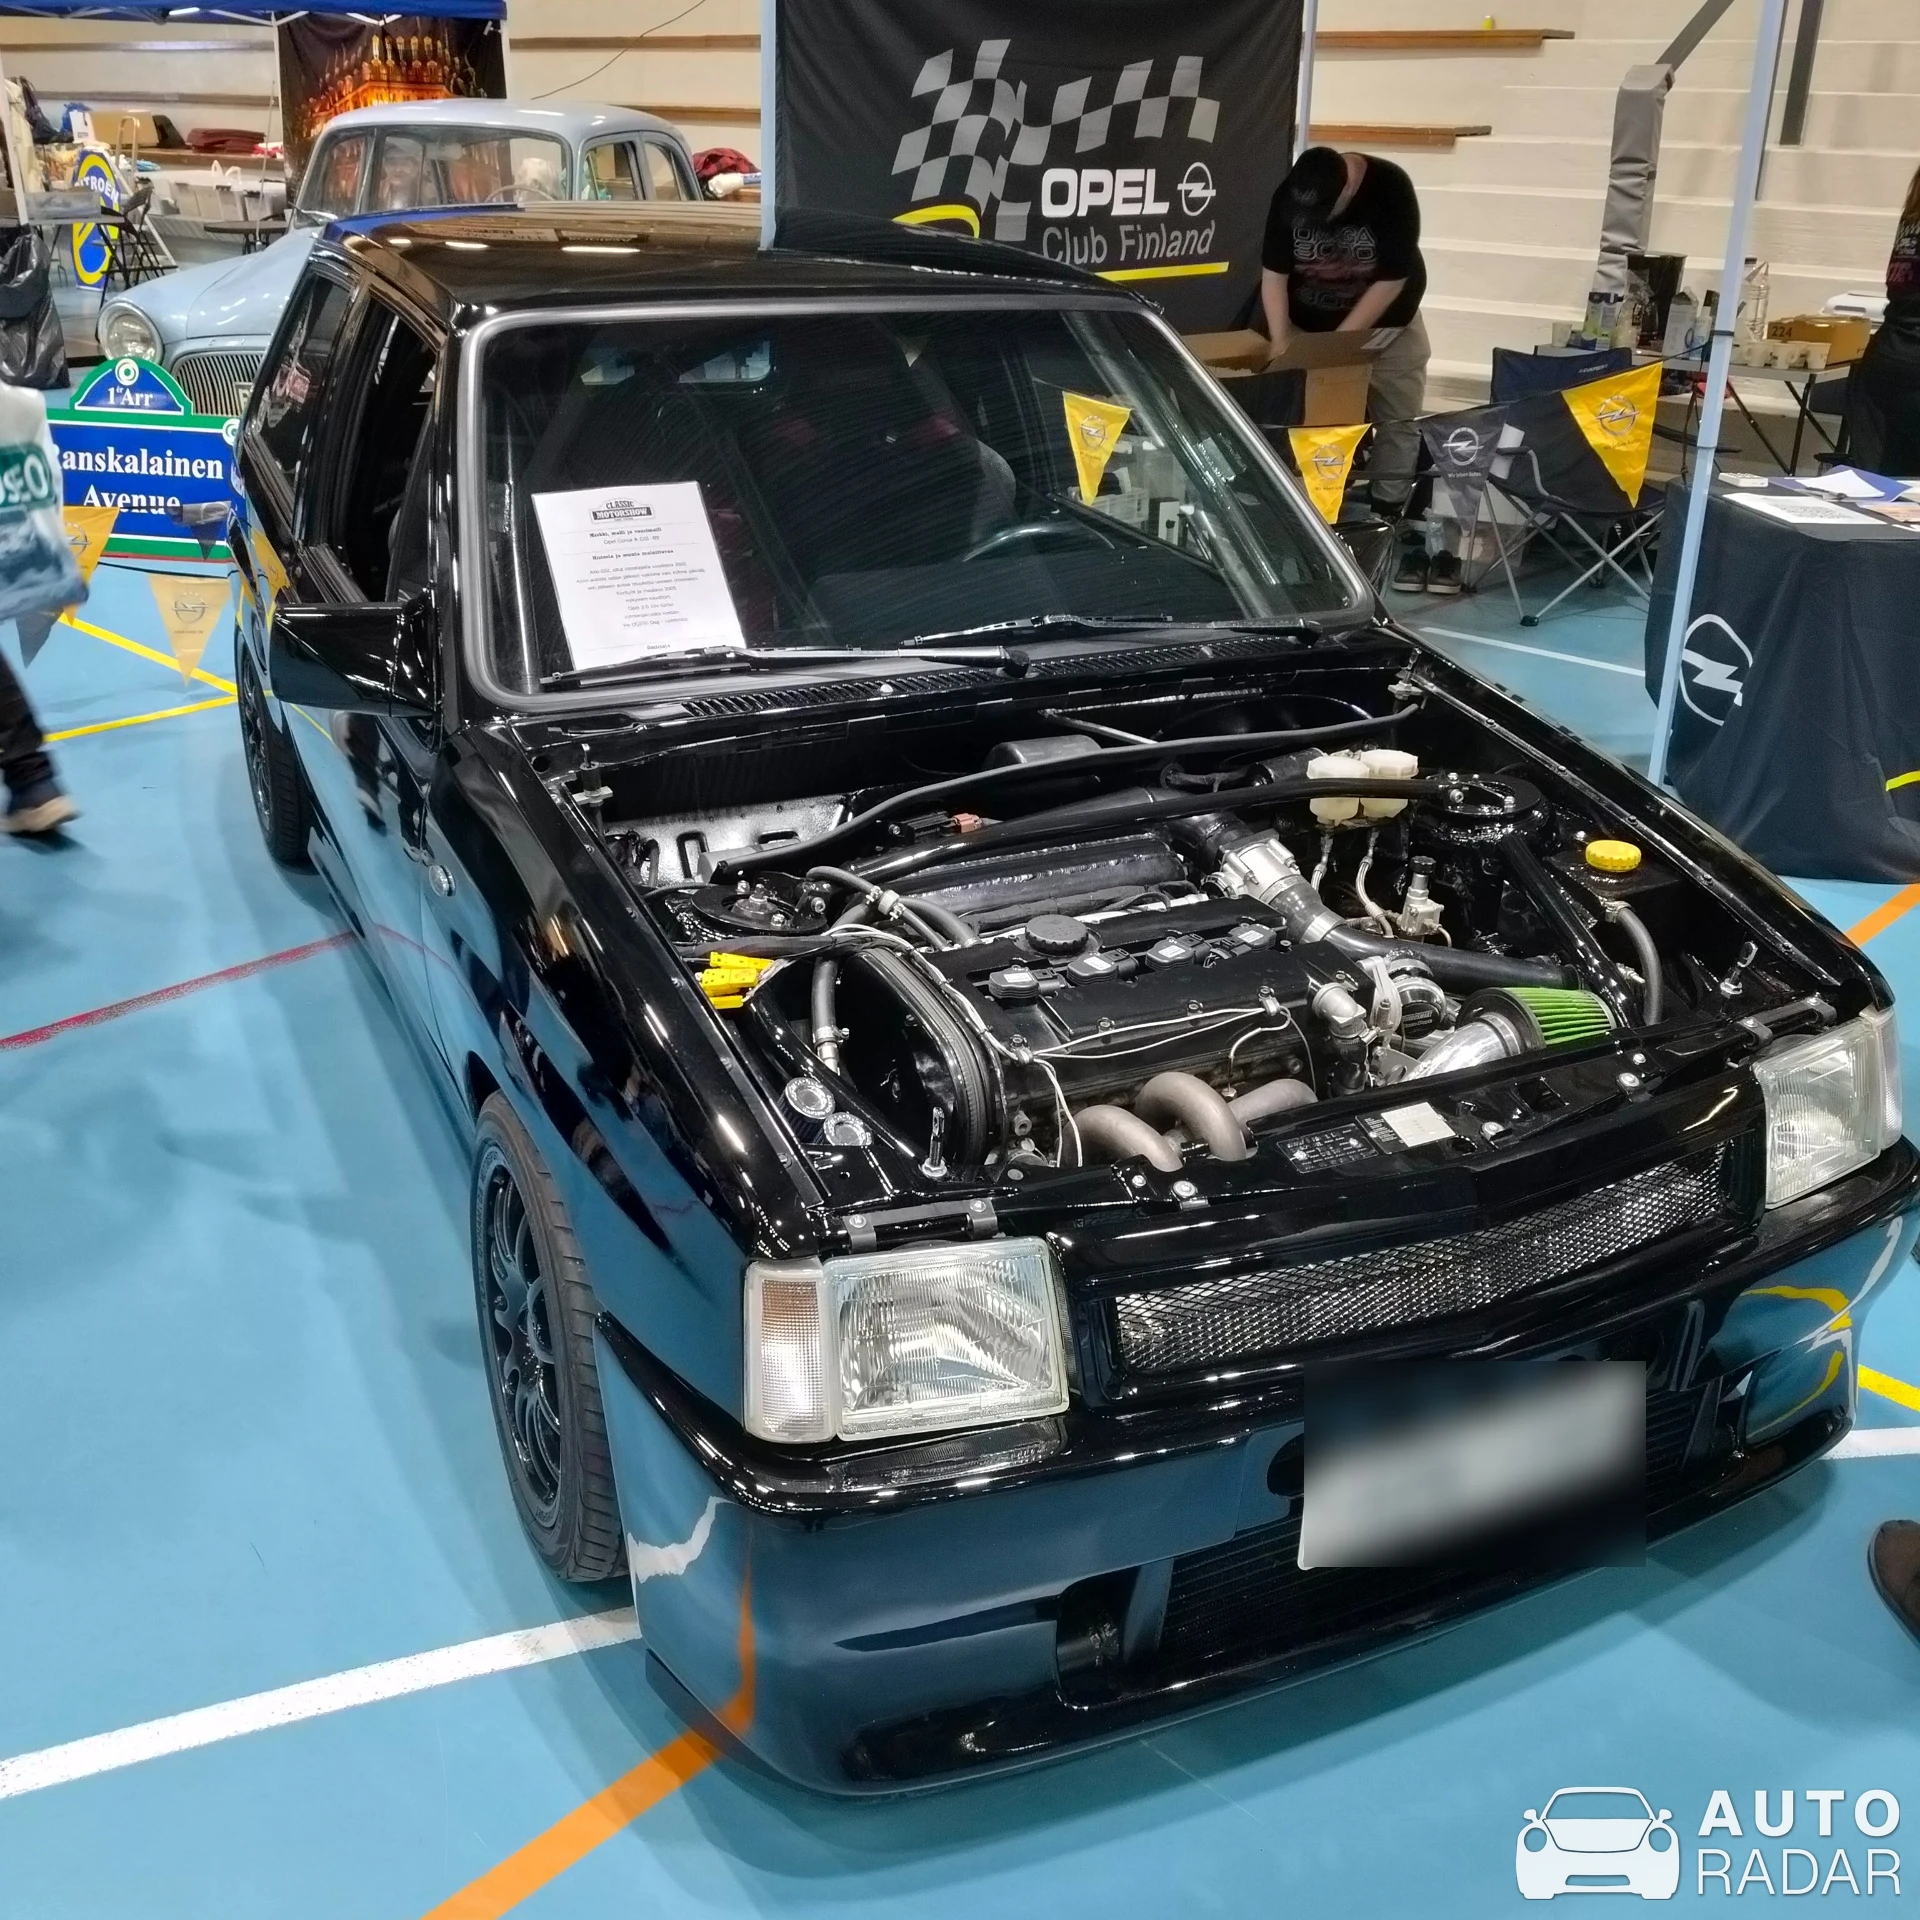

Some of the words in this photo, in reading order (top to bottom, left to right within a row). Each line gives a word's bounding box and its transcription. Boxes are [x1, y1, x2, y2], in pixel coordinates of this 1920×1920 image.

[1042, 168, 1169, 217] OPEL
[1043, 226, 1108, 264] Club
[1119, 220, 1216, 261] Finland
[1771, 325, 1793, 338] 224
[83, 484, 181, 515] Avenue
[606, 500, 634, 509] CLASSIC
[596, 508, 648, 519] MOTORSHOW
